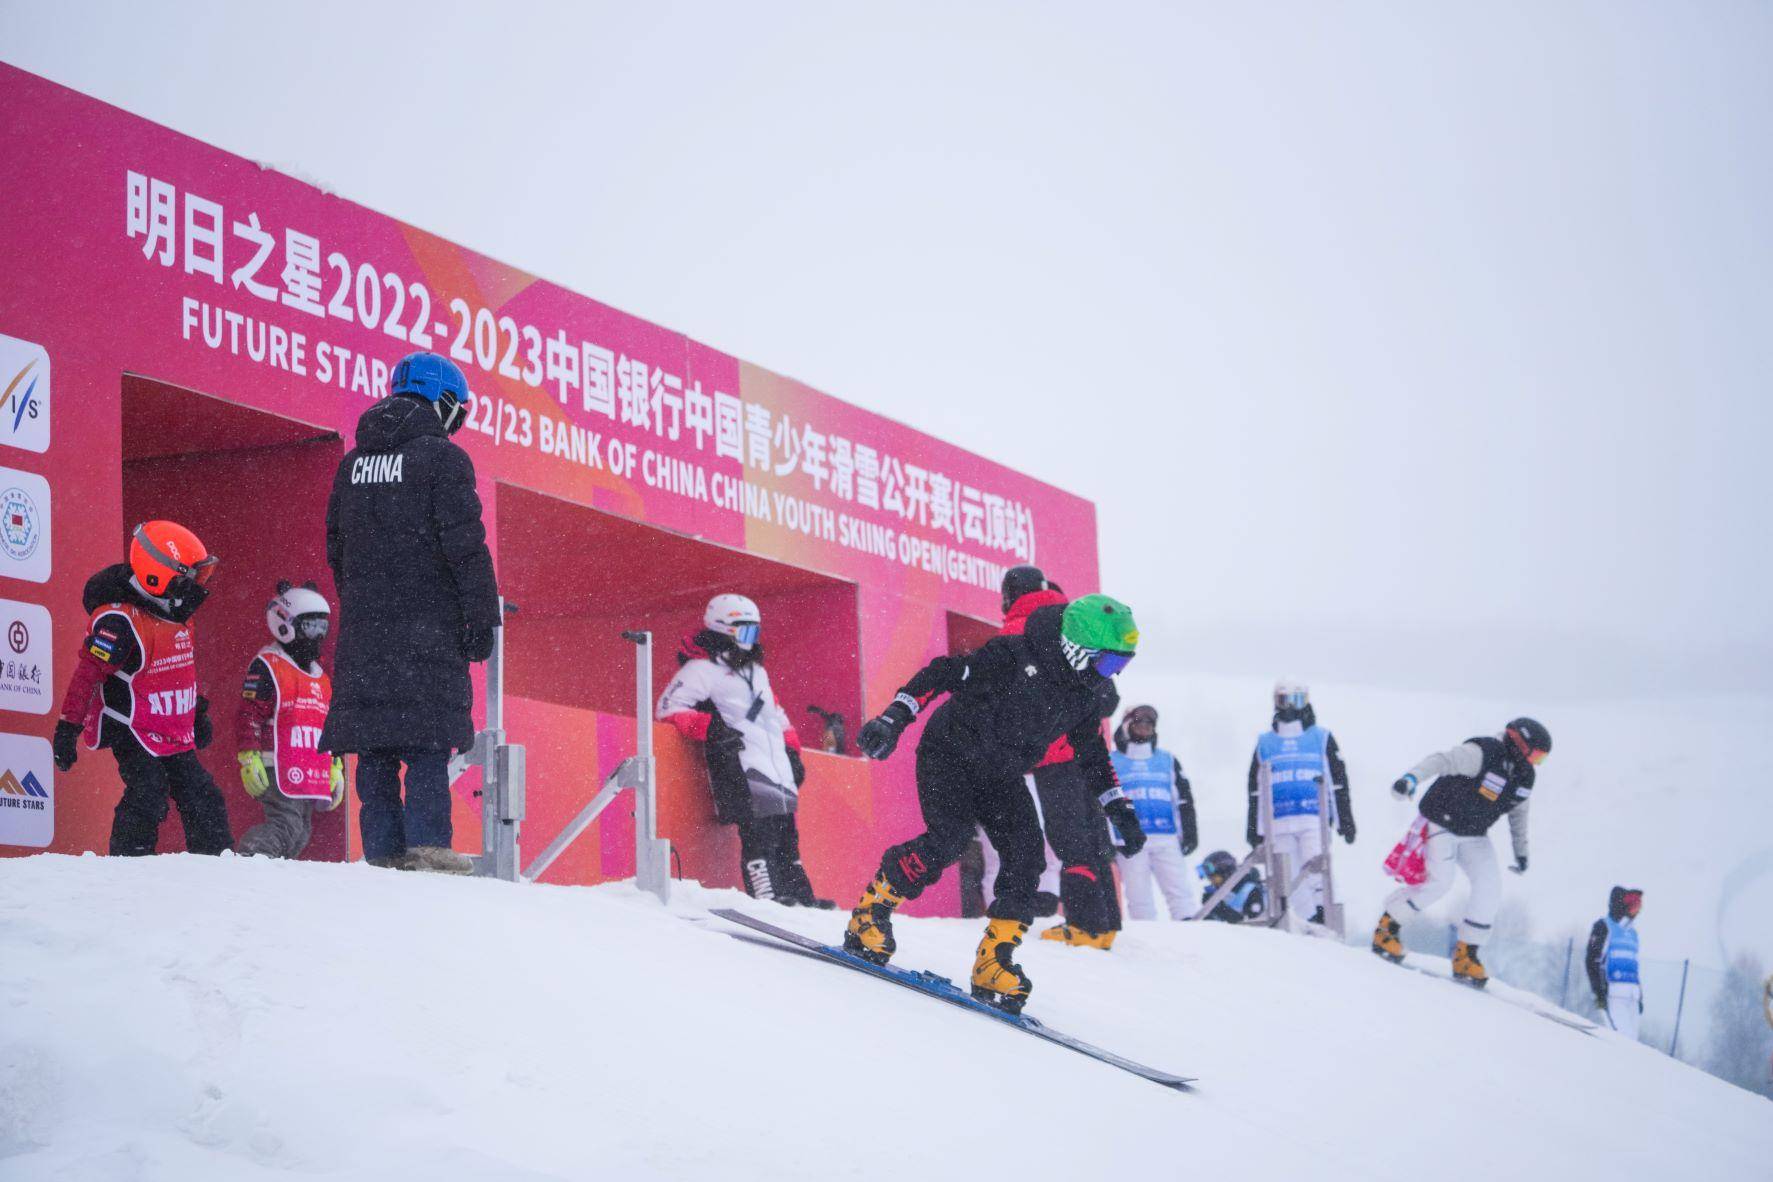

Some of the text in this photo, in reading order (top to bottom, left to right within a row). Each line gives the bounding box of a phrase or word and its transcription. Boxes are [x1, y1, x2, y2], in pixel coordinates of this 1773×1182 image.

[182, 296, 307, 377] FUTURE
[315, 341, 396, 399] STAR
[539, 414, 604, 470] BANK
[607, 438, 637, 479] OF
[641, 449, 709, 503] CHINA
[710, 471, 772, 522] CHINA
[772, 491, 835, 543] YOUTH
[838, 513, 897, 561] SKIING
[351, 453, 403, 485] CHINA
[22, 799, 45, 810] STARS
